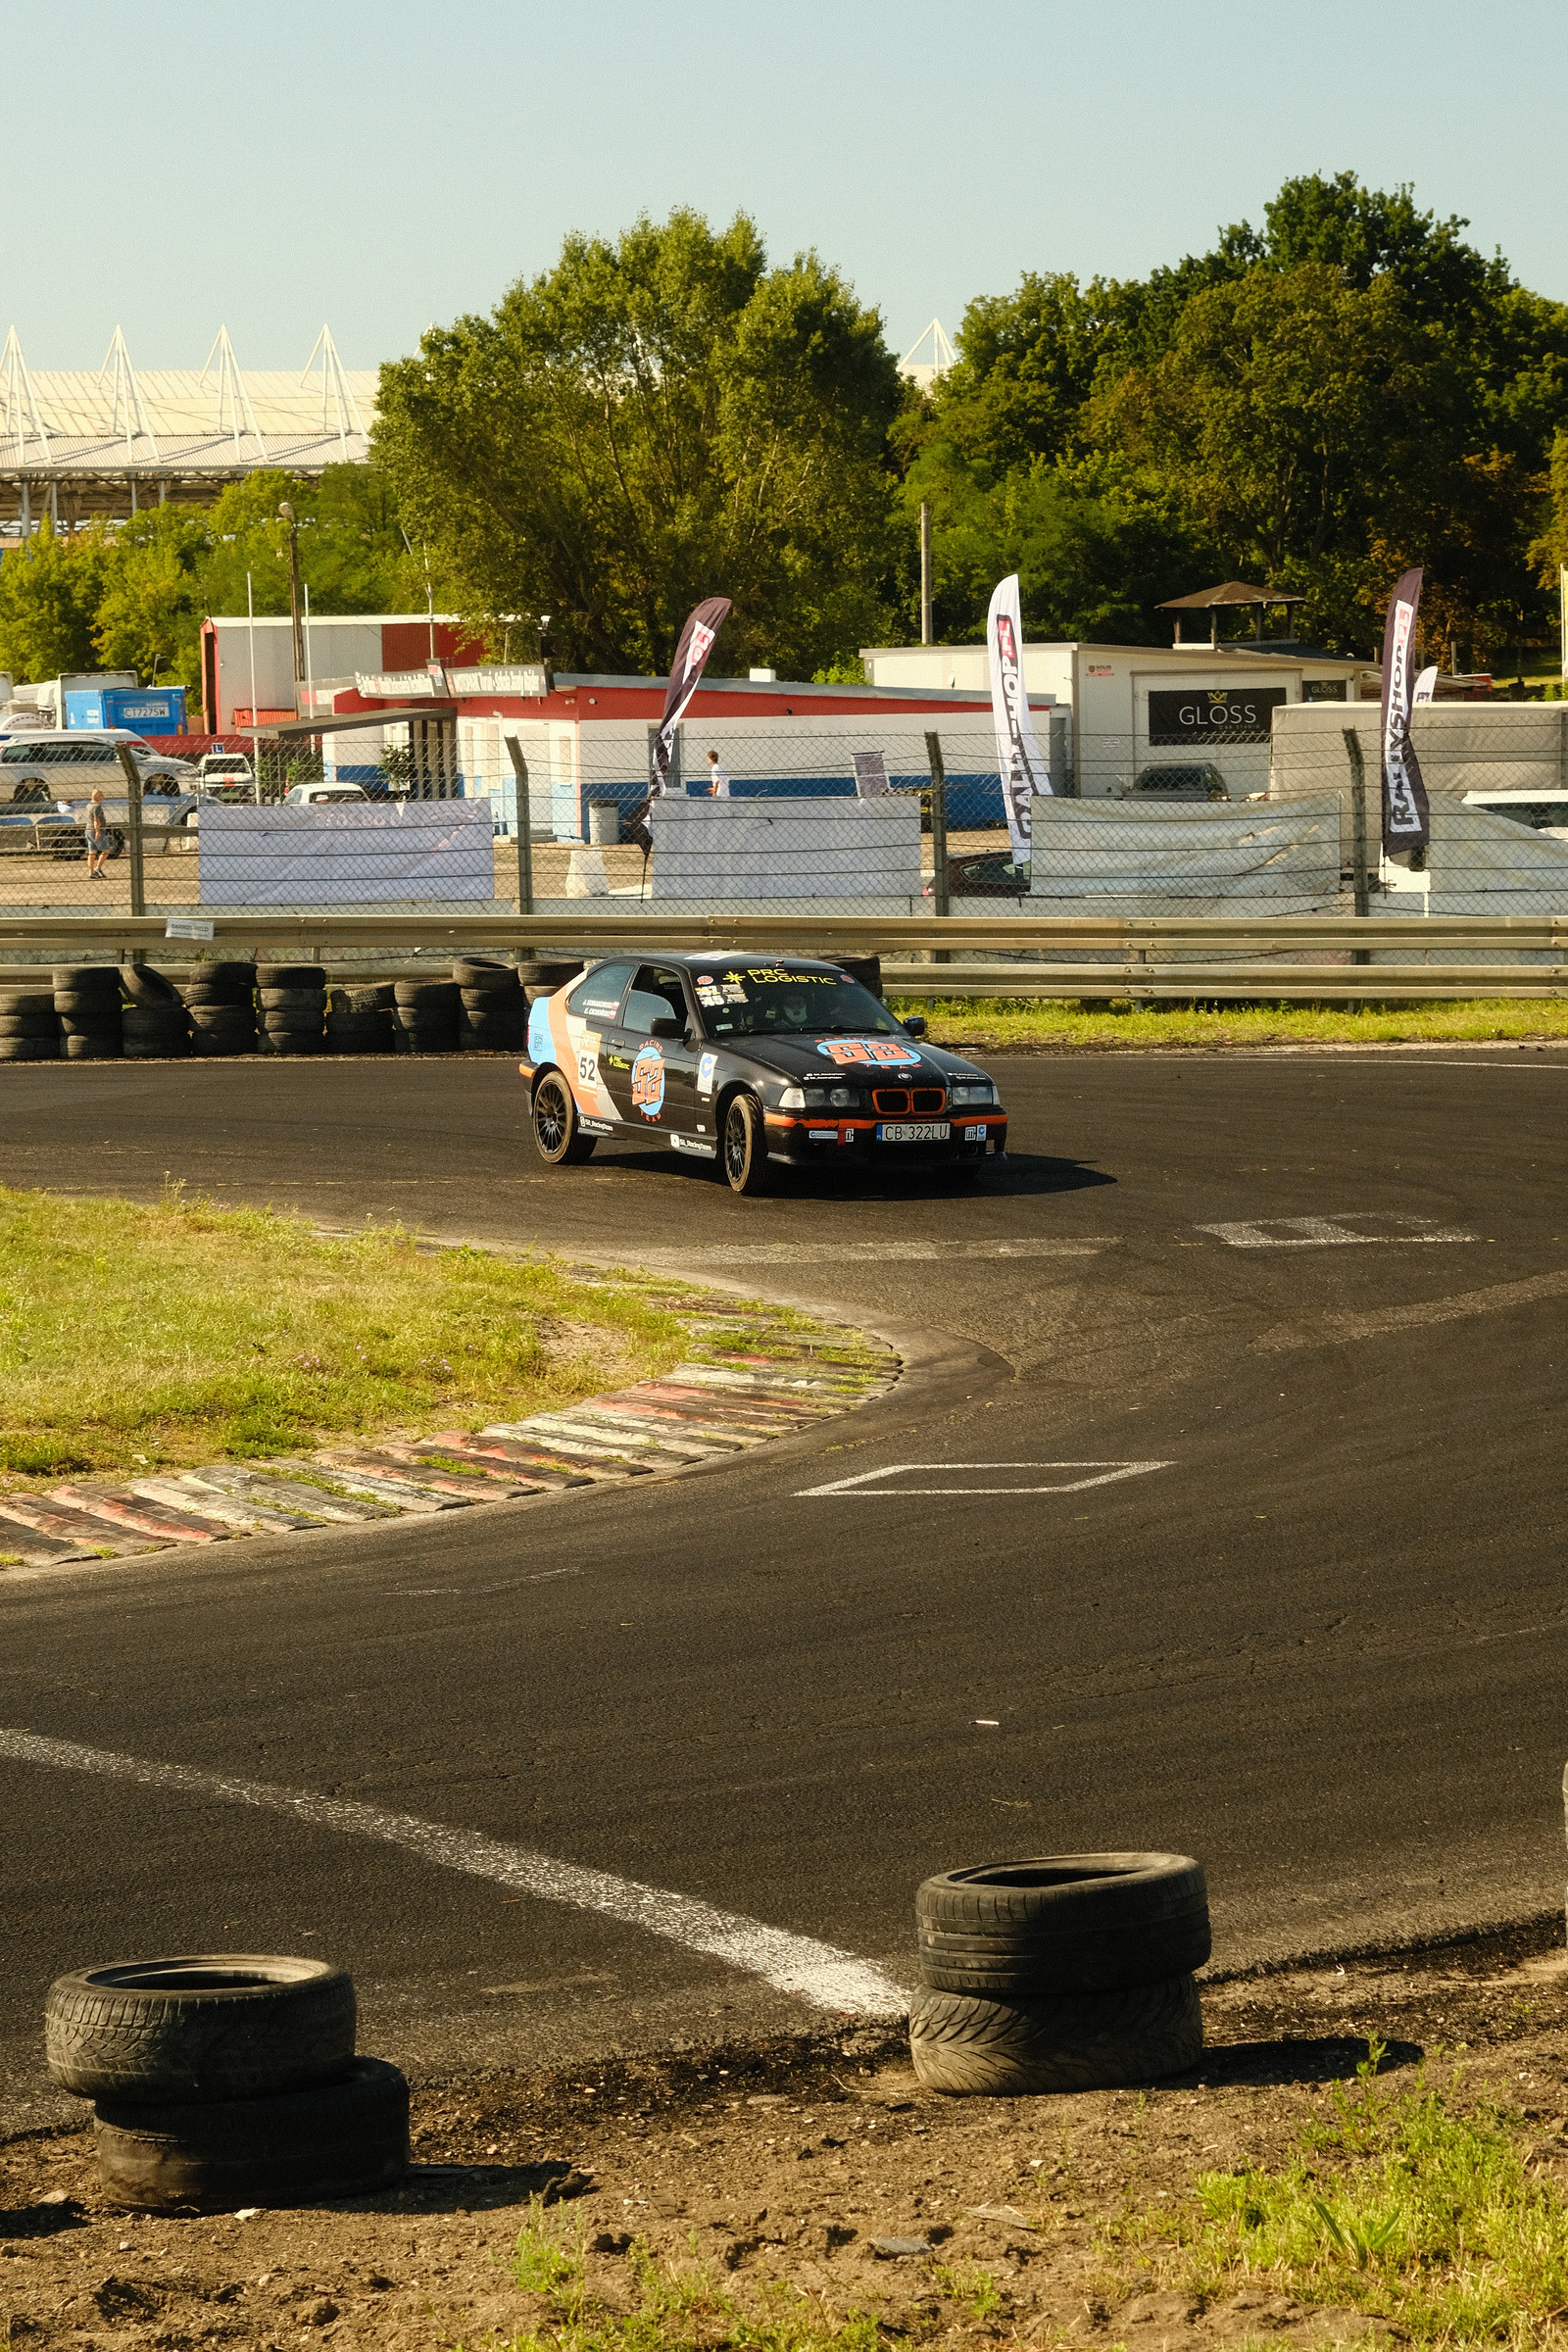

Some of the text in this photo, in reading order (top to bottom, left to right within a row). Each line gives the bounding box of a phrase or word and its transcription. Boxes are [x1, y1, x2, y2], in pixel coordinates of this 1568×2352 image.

[1179, 705, 1257, 725] GLOSS
[747, 968, 789, 977] PRC
[752, 975, 838, 985] LOGISTIC
[638, 1039, 663, 1054] RACING
[579, 1056, 596, 1081] 52
[640, 1109, 662, 1122] TEAM
[885, 1125, 948, 1140] CB 322LU
